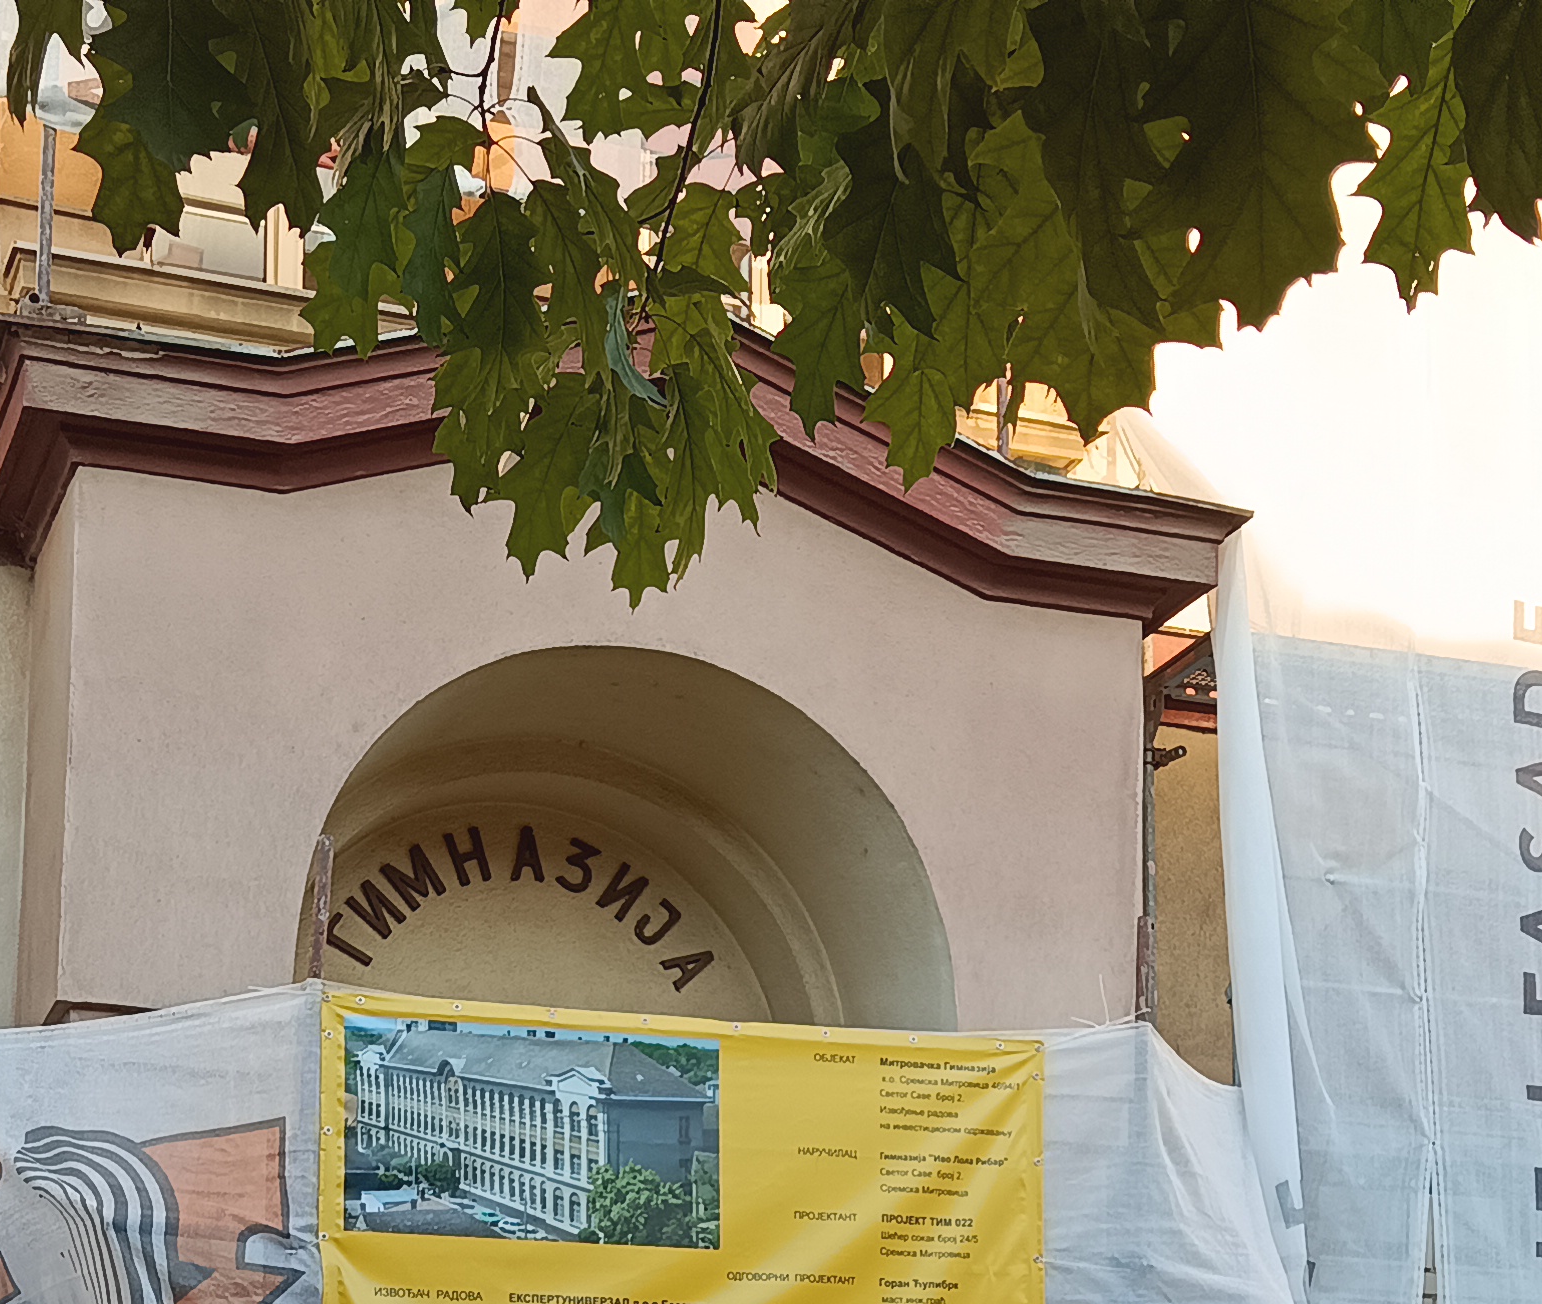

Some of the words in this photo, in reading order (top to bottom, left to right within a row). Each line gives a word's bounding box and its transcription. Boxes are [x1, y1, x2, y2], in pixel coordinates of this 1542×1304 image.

[325, 825, 716, 994] ГИМНАЗИЈА
[813, 1052, 857, 1065] ОБЈЕКАТ
[879, 1057, 942, 1071] Митровачка
[944, 1062, 997, 1076] Гимназија
[879, 1089, 909, 1099] Светог
[910, 1091, 932, 1101] Саве
[935, 1092, 956, 1104] број
[879, 1105, 925, 1120] Извођење
[927, 1110, 959, 1121] радова
[879, 1122, 892, 1131] на
[892, 1123, 962, 1135] инвестиционом
[797, 1146, 858, 1160] НАРУЧИЛАЦ
[879, 1151, 927, 1164] Гимназија
[952, 1155, 974, 1165] Лола
[879, 1167, 909, 1178] Светог
[911, 1169, 933, 1179] Саве
[936, 1169, 956, 1182] број
[879, 1183, 920, 1195] Сремска
[921, 1185, 969, 1198] Митровица
[793, 1210, 858, 1222] ПРОЈЕКТАНТ
[881, 1213, 928, 1226] ПРОЈЕКТ
[929, 1216, 953, 1227] ТИМ
[954, 1217, 974, 1228] 022
[880, 1231, 910, 1243] Шећер
[937, 1233, 958, 1245] број
[959, 1234, 979, 1244] 24/5
[879, 1246, 918, 1259] Сремска
[919, 1249, 971, 1260] Митровица
[726, 1270, 790, 1283] ОДГОВОРНИ
[794, 1273, 856, 1286] ПРОЈЕКТАНТ
[878, 1277, 910, 1290] Горан
[373, 1286, 431, 1302] ИЗВОЂАЧ
[436, 1288, 484, 1302] РАДОВА
